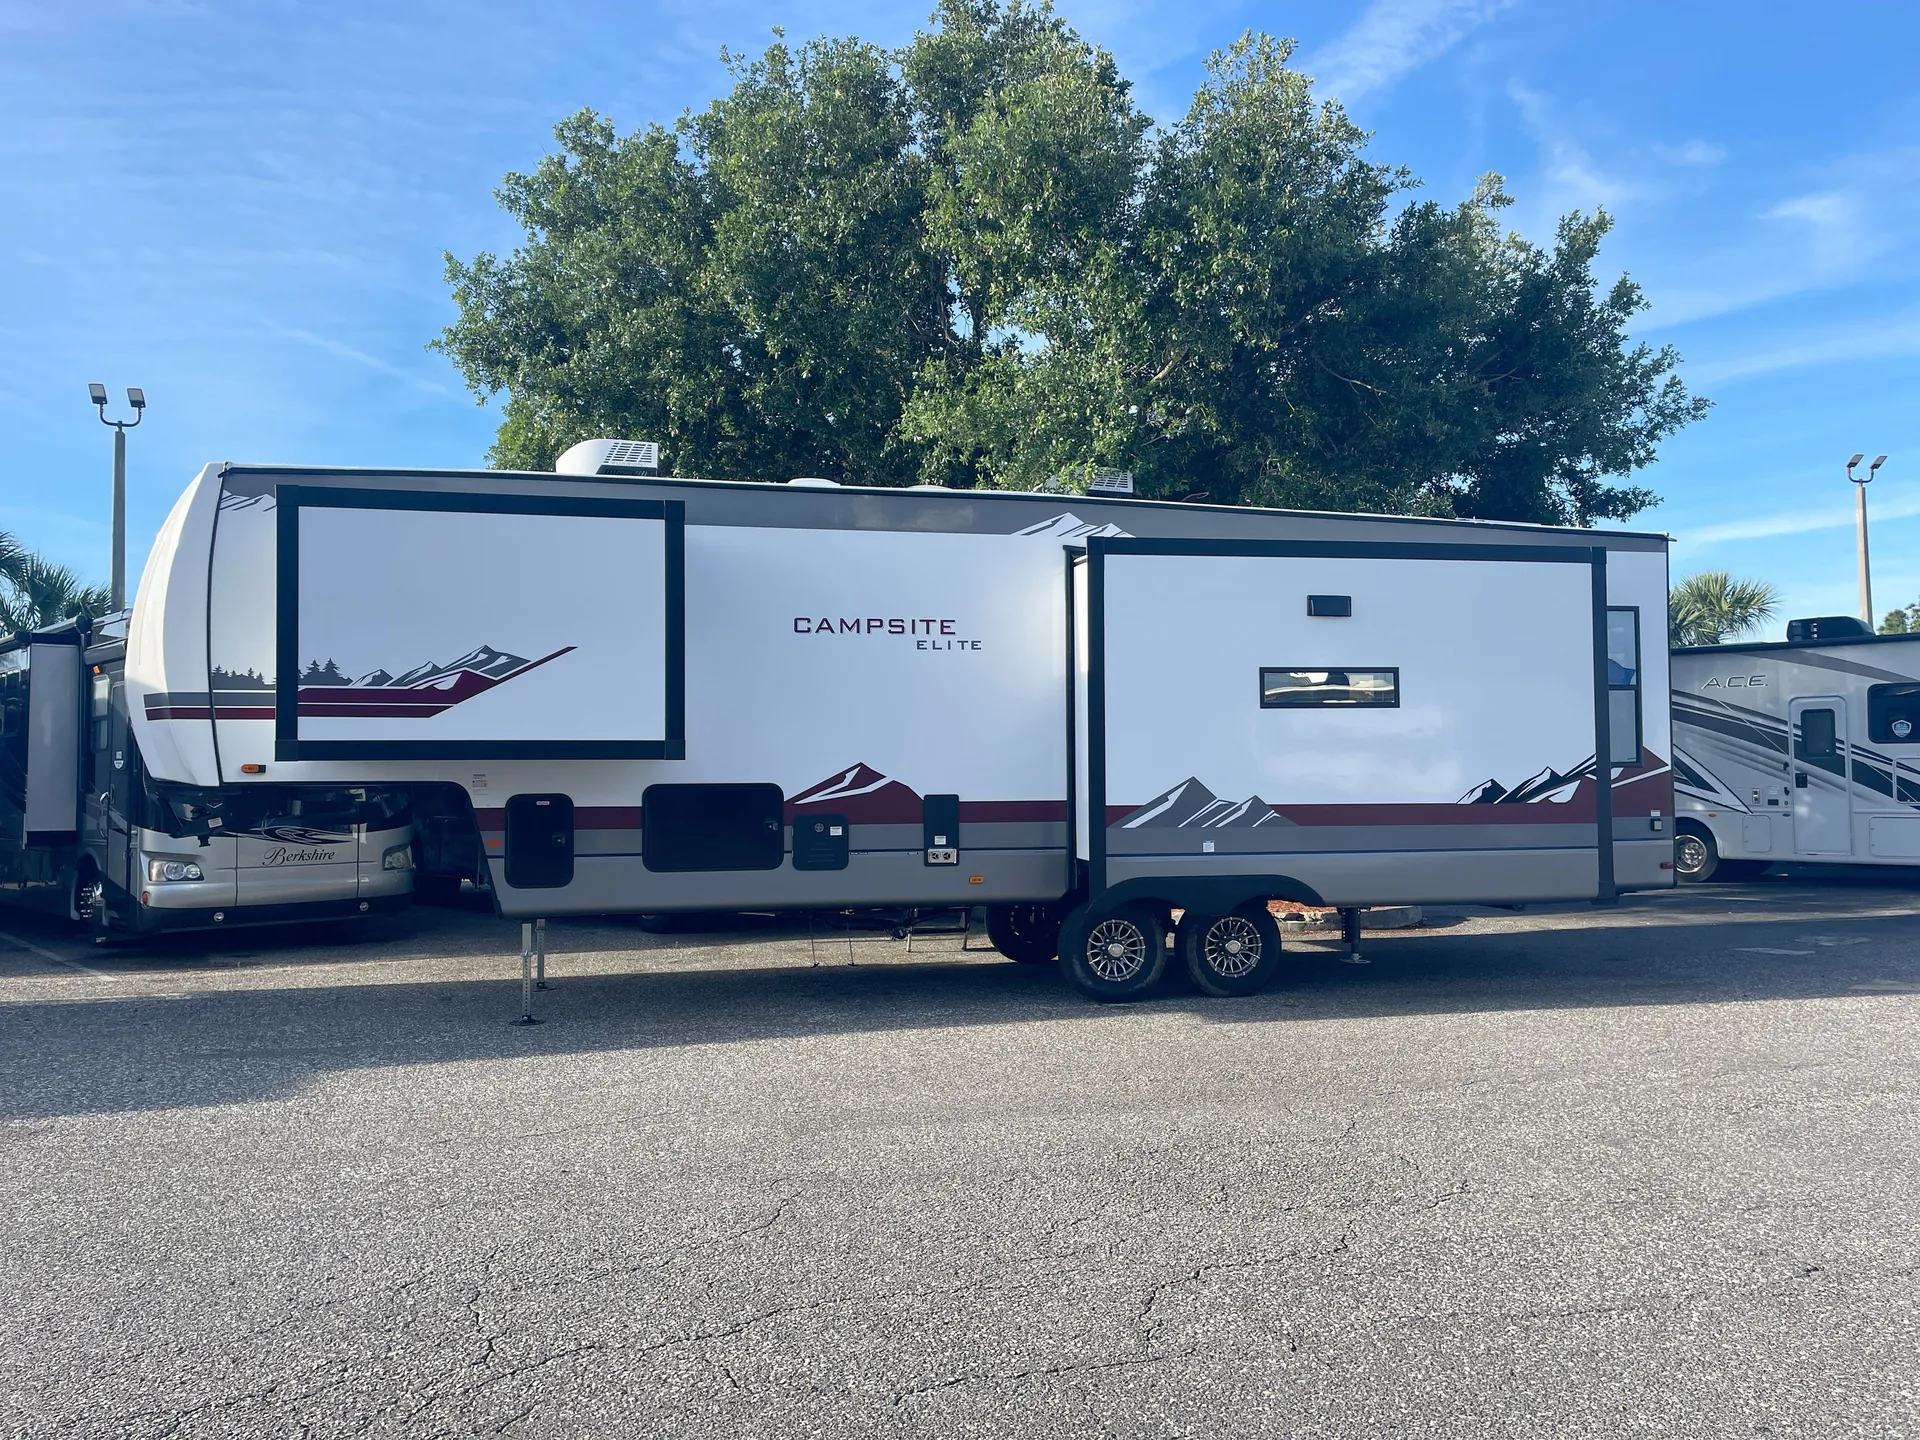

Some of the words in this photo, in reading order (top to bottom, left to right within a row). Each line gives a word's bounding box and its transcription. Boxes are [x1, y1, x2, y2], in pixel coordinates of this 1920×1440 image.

[793, 617, 956, 635] CAMPSITE
[916, 640, 982, 651] ELITE
[262, 846, 335, 866] Berkshire
